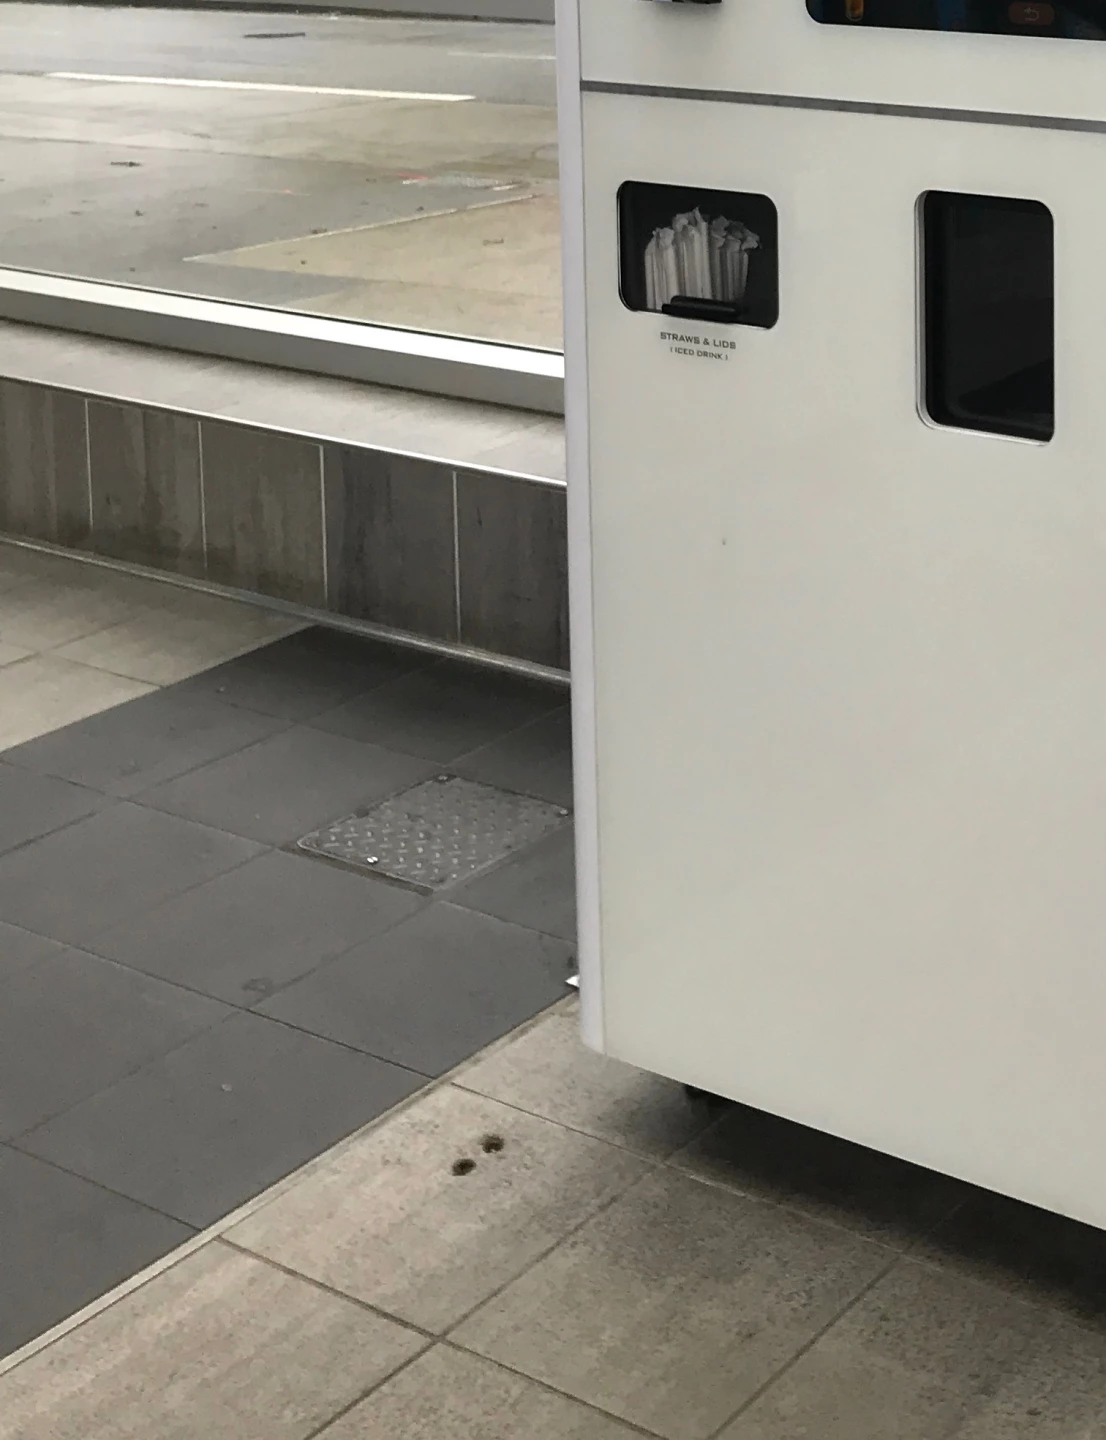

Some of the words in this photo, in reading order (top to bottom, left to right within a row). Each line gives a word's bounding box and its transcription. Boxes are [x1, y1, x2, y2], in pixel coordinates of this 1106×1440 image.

[660, 331, 700, 345] STRAWS
[703, 337, 710, 346] &
[713, 339, 736, 350] LIDS
[675, 347, 695, 356] ICED
[697, 350, 723, 360] DRINK
